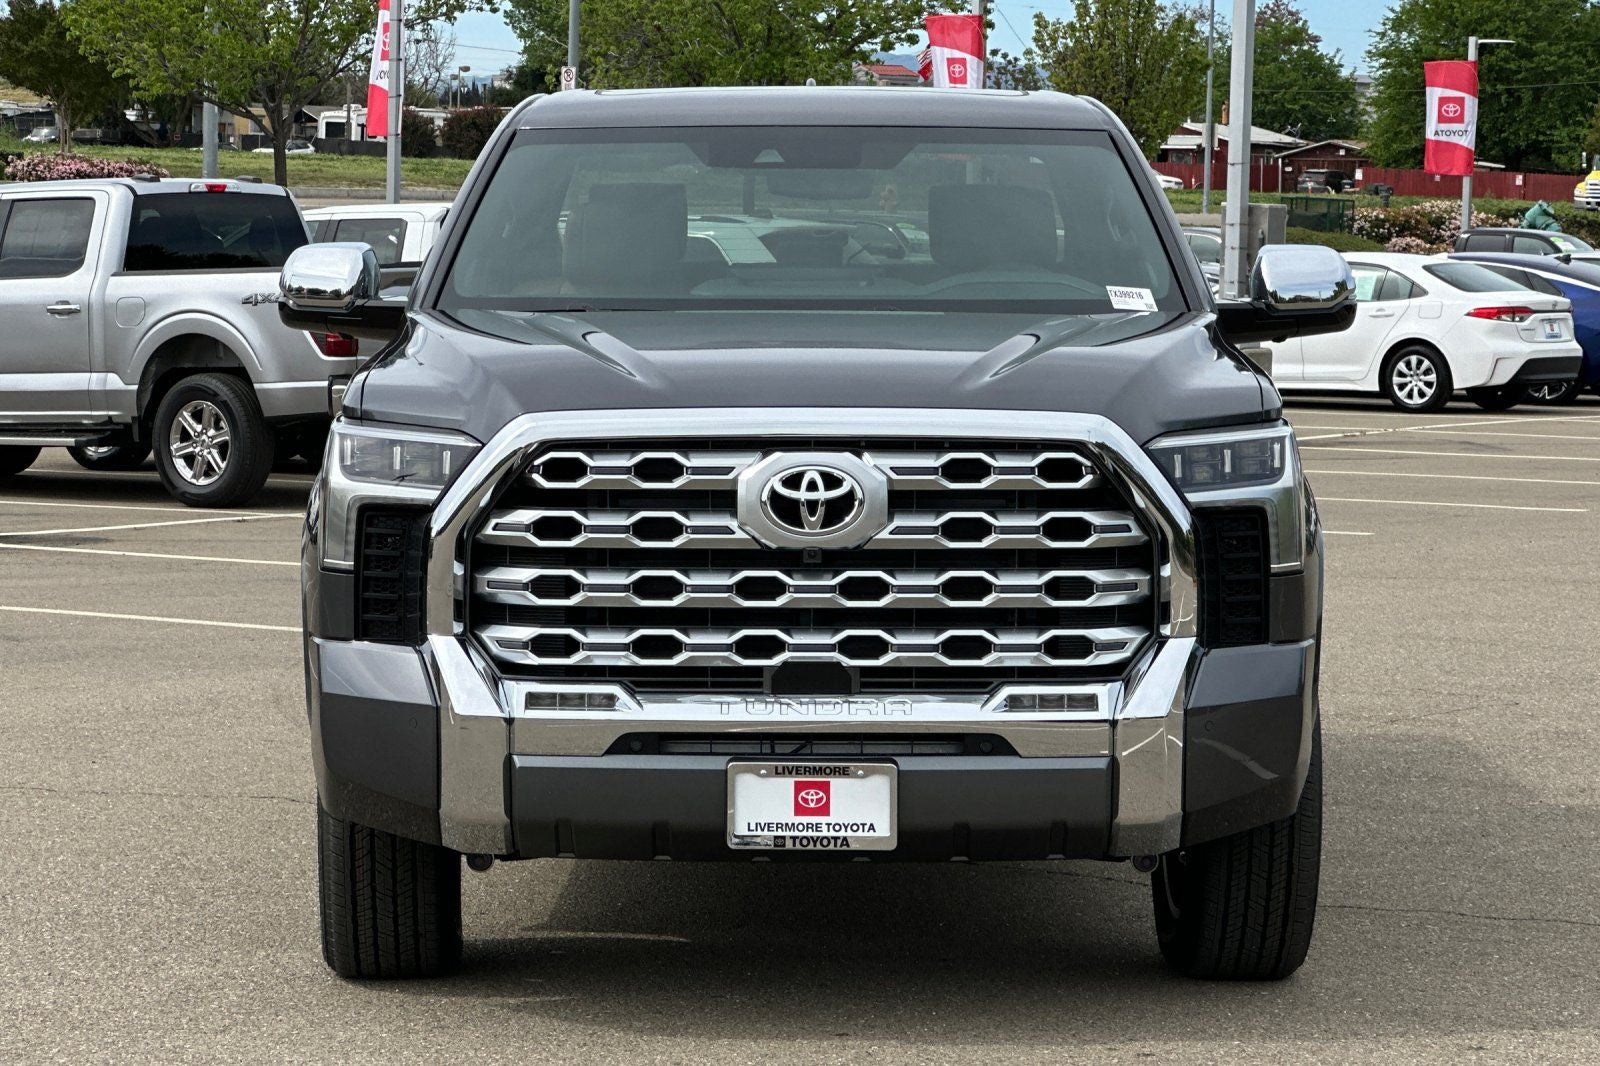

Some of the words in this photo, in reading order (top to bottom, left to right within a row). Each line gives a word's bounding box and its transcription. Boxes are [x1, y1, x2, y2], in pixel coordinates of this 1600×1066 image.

[710, 698, 913, 715] TUNDRA
[774, 765, 850, 777] LIVERMORE
[747, 822, 823, 833] LIVERMORE
[825, 822, 876, 833] TOYOTA
[790, 836, 850, 848] TOYOTA
